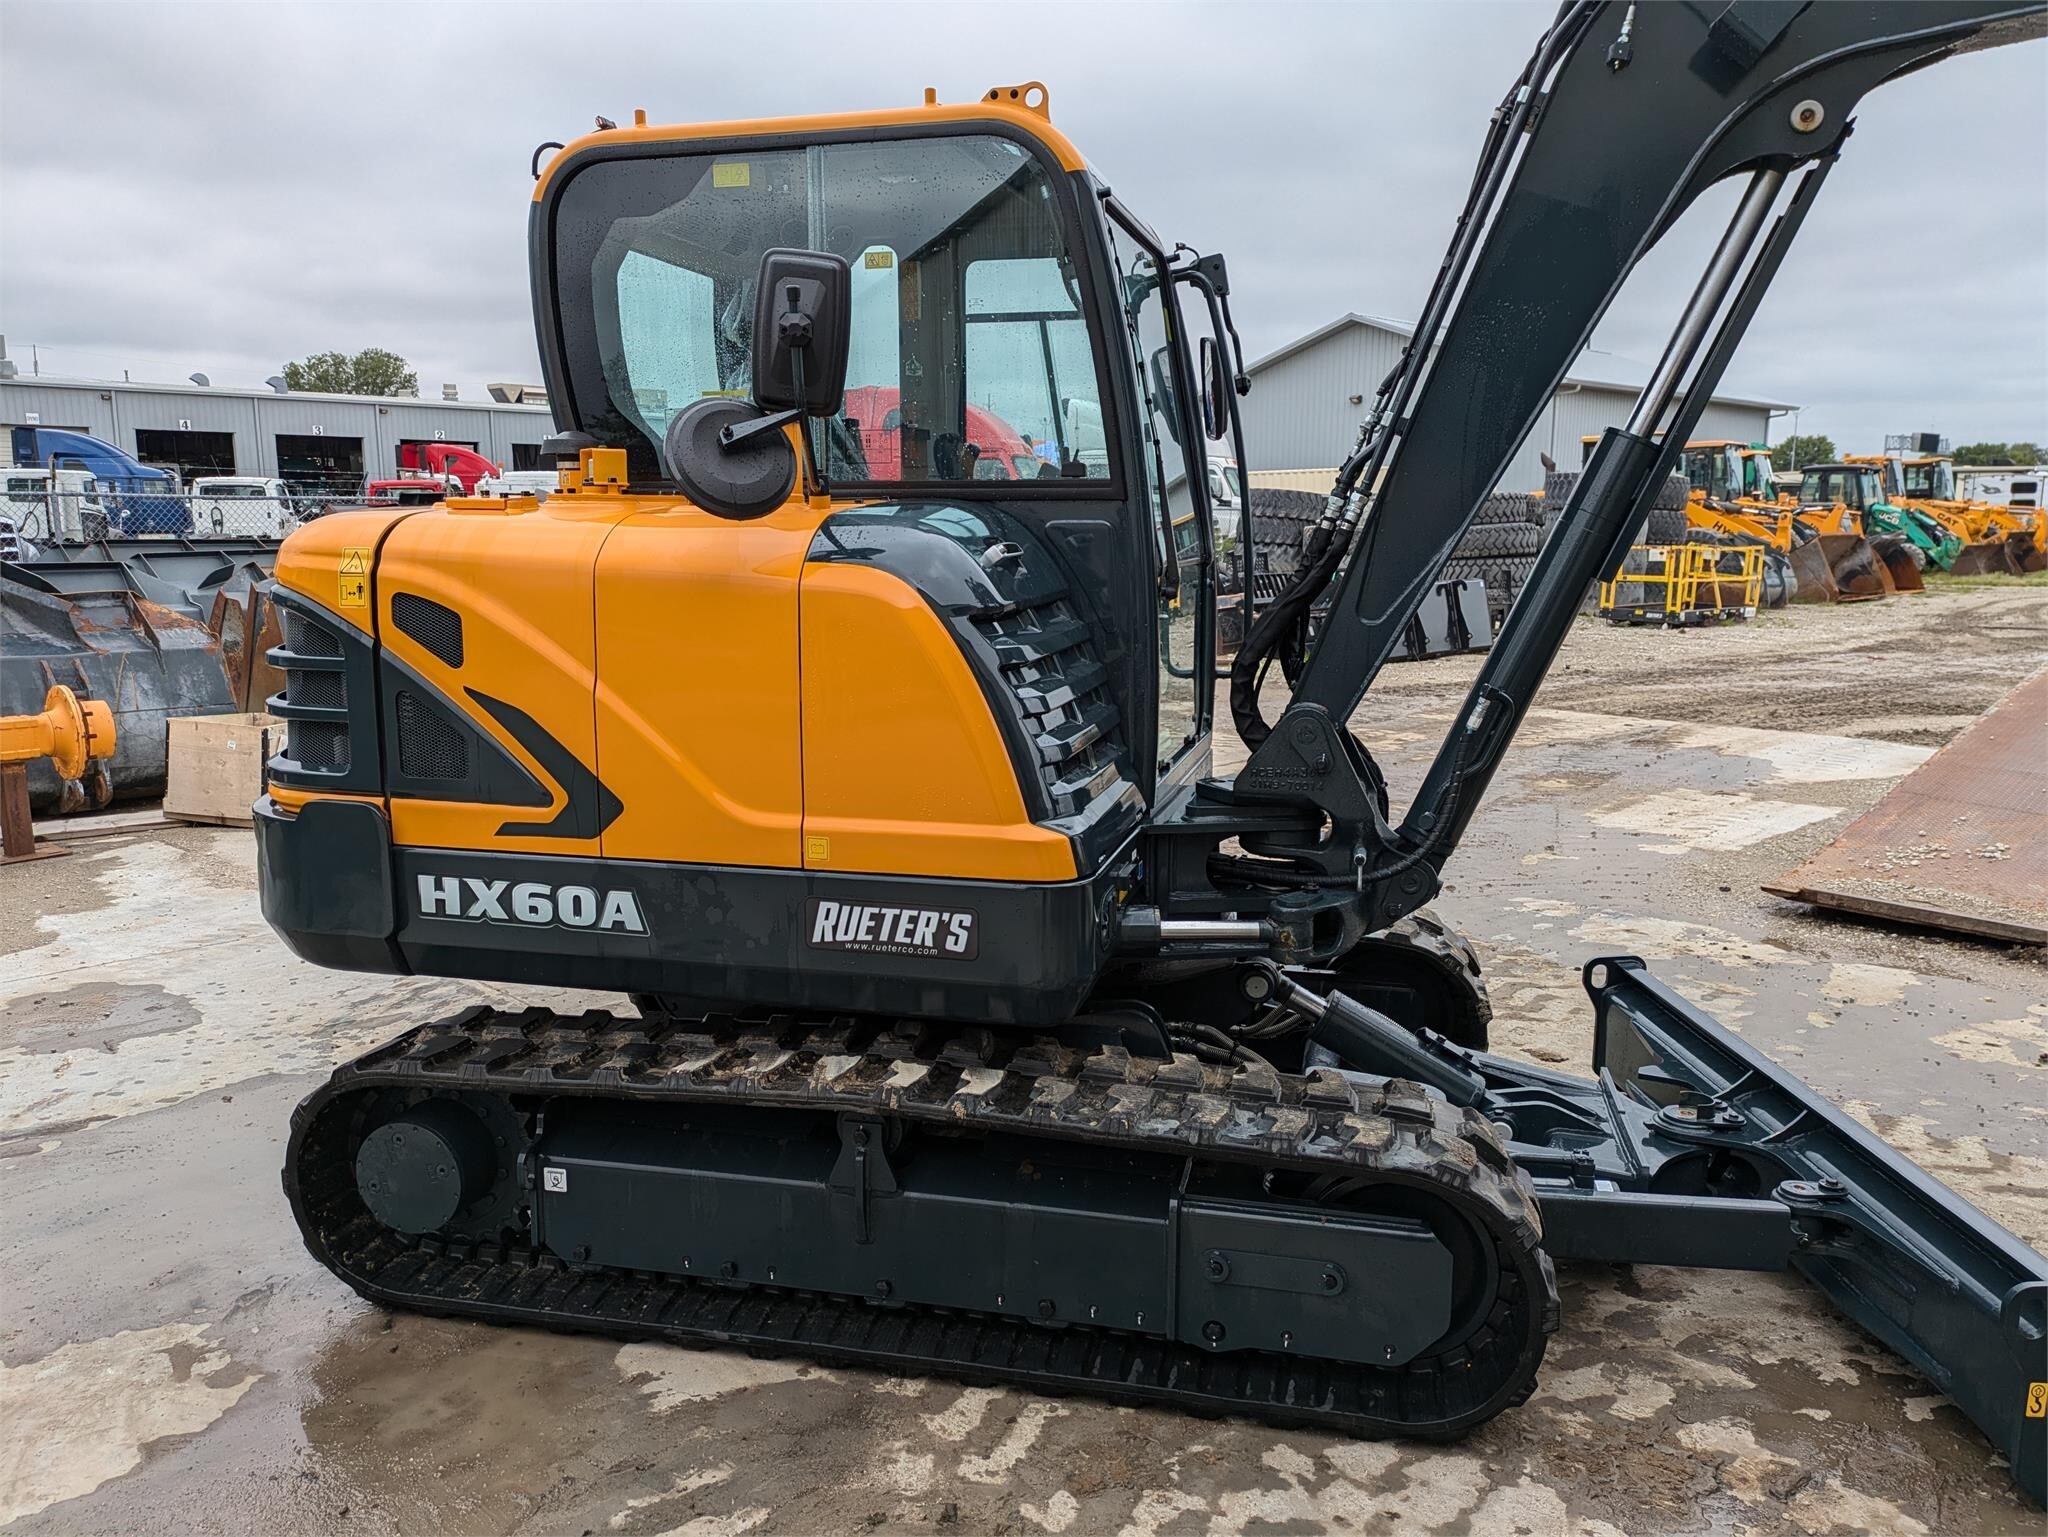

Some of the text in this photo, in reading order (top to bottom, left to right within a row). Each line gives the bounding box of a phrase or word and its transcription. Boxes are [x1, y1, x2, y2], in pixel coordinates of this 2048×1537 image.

[181, 420, 189, 430] 4
[314, 425, 322, 435] 3
[436, 430, 444, 440] 2
[1878, 512, 1900, 526] JCB
[1936, 512, 1960, 526] CAT
[417, 874, 645, 932] HX60A
[811, 901, 973, 953] RUETER'S
[844, 942, 939, 956] www.rueterco.com
